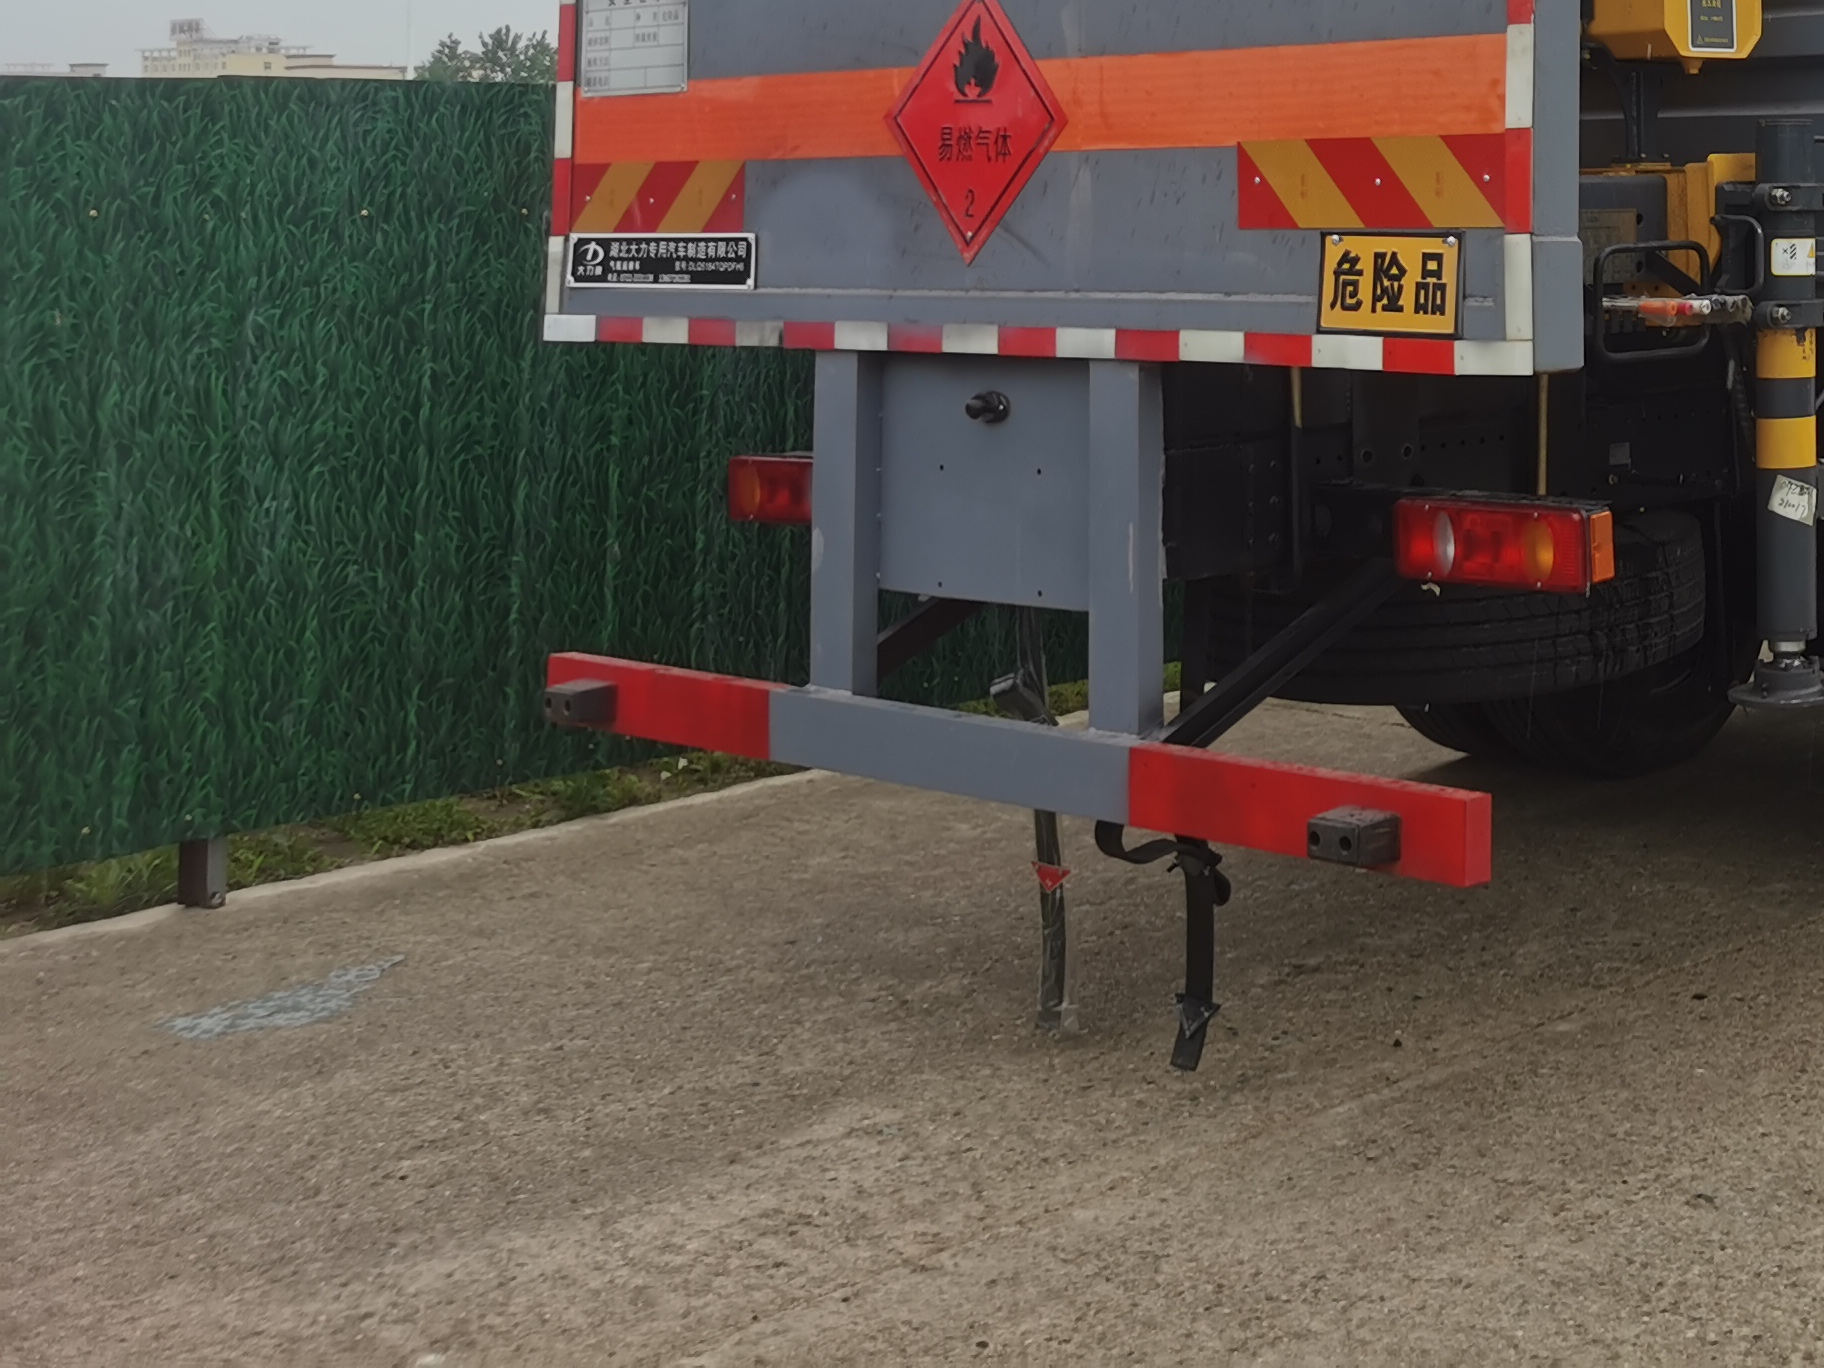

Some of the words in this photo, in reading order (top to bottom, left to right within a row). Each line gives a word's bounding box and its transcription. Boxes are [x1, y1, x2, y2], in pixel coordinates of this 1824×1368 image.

[938, 125, 1012, 164] 易燃气体
[965, 188, 975, 218] 2
[1329, 248, 1448, 317] 危险品
